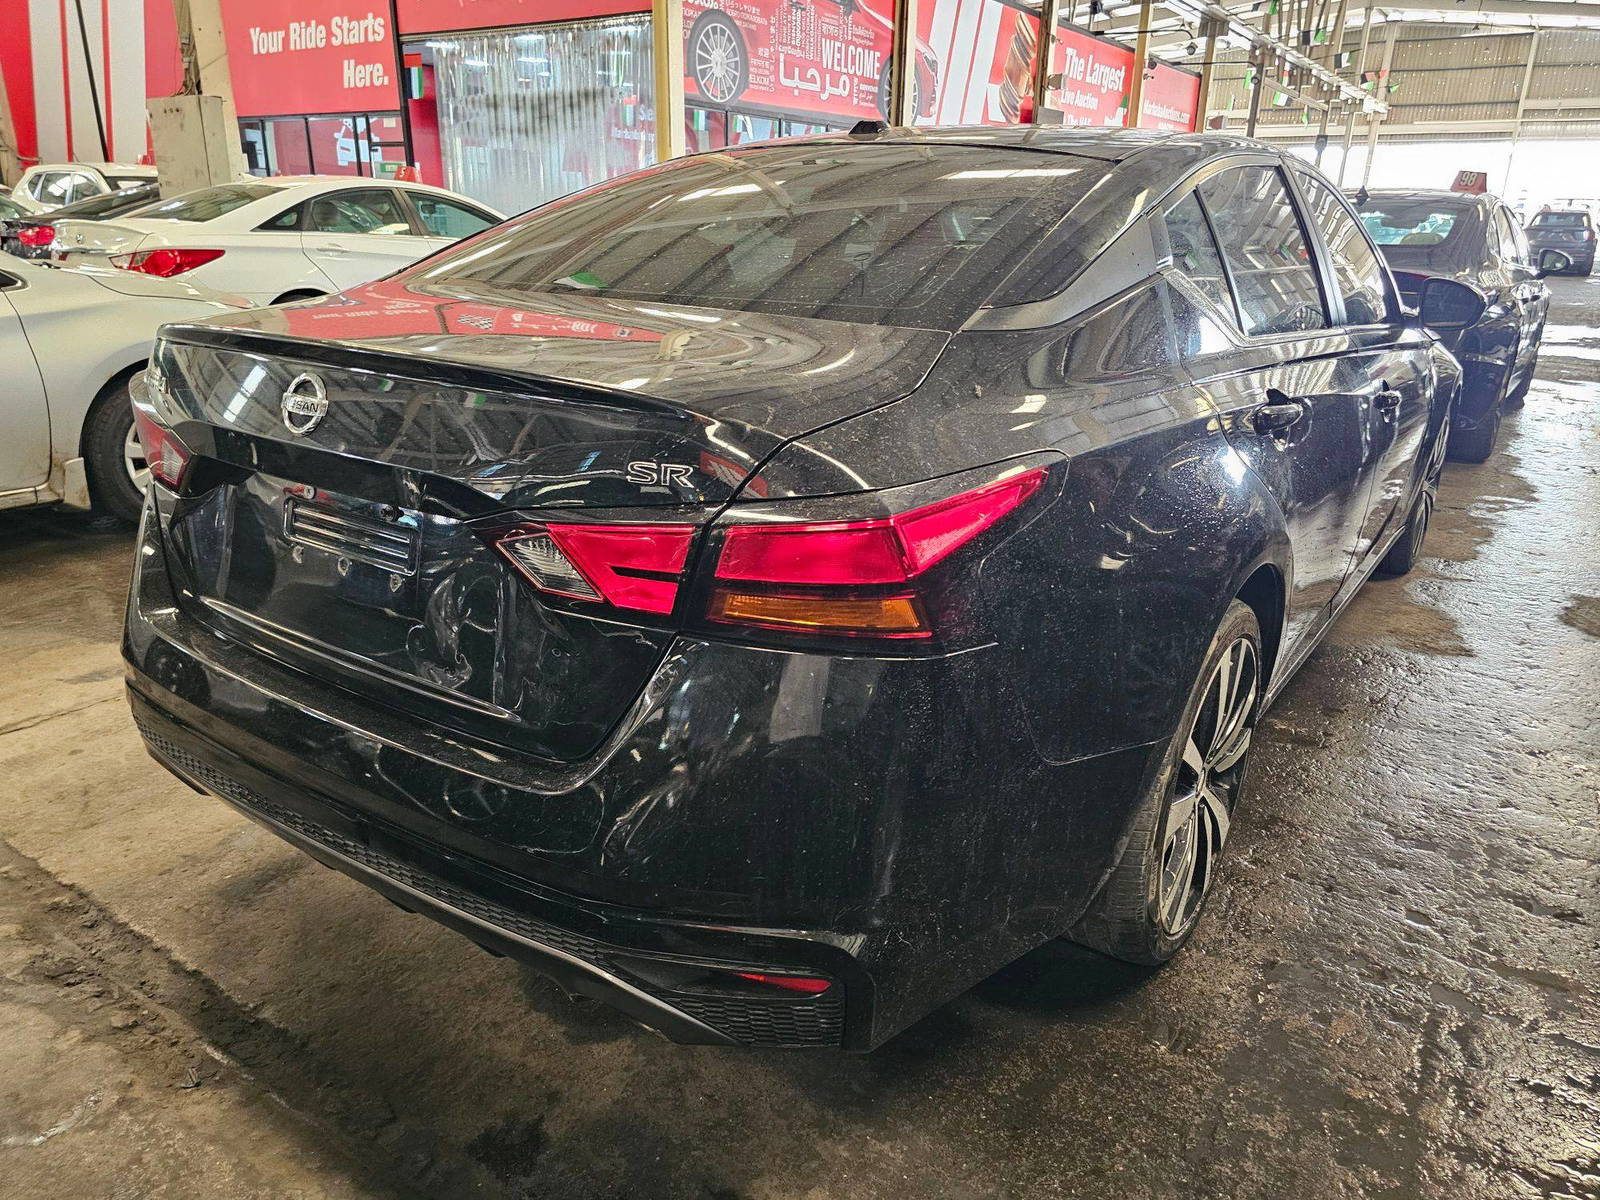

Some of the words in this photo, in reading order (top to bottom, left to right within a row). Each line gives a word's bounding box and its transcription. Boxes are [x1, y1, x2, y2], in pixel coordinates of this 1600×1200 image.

[249, 27, 286, 55] Your
[289, 20, 327, 51] Ride
[331, 12, 385, 47] Starts
[343, 59, 389, 89] Here.
[778, 51, 850, 100] مرحبا
[821, 38, 881, 79] WELCOME
[1065, 47, 1085, 81] The
[1087, 54, 1126, 94] Largest
[1060, 87, 1075, 106] Live
[1074, 89, 1099, 110] Auction
[625, 461, 695, 489] SR
